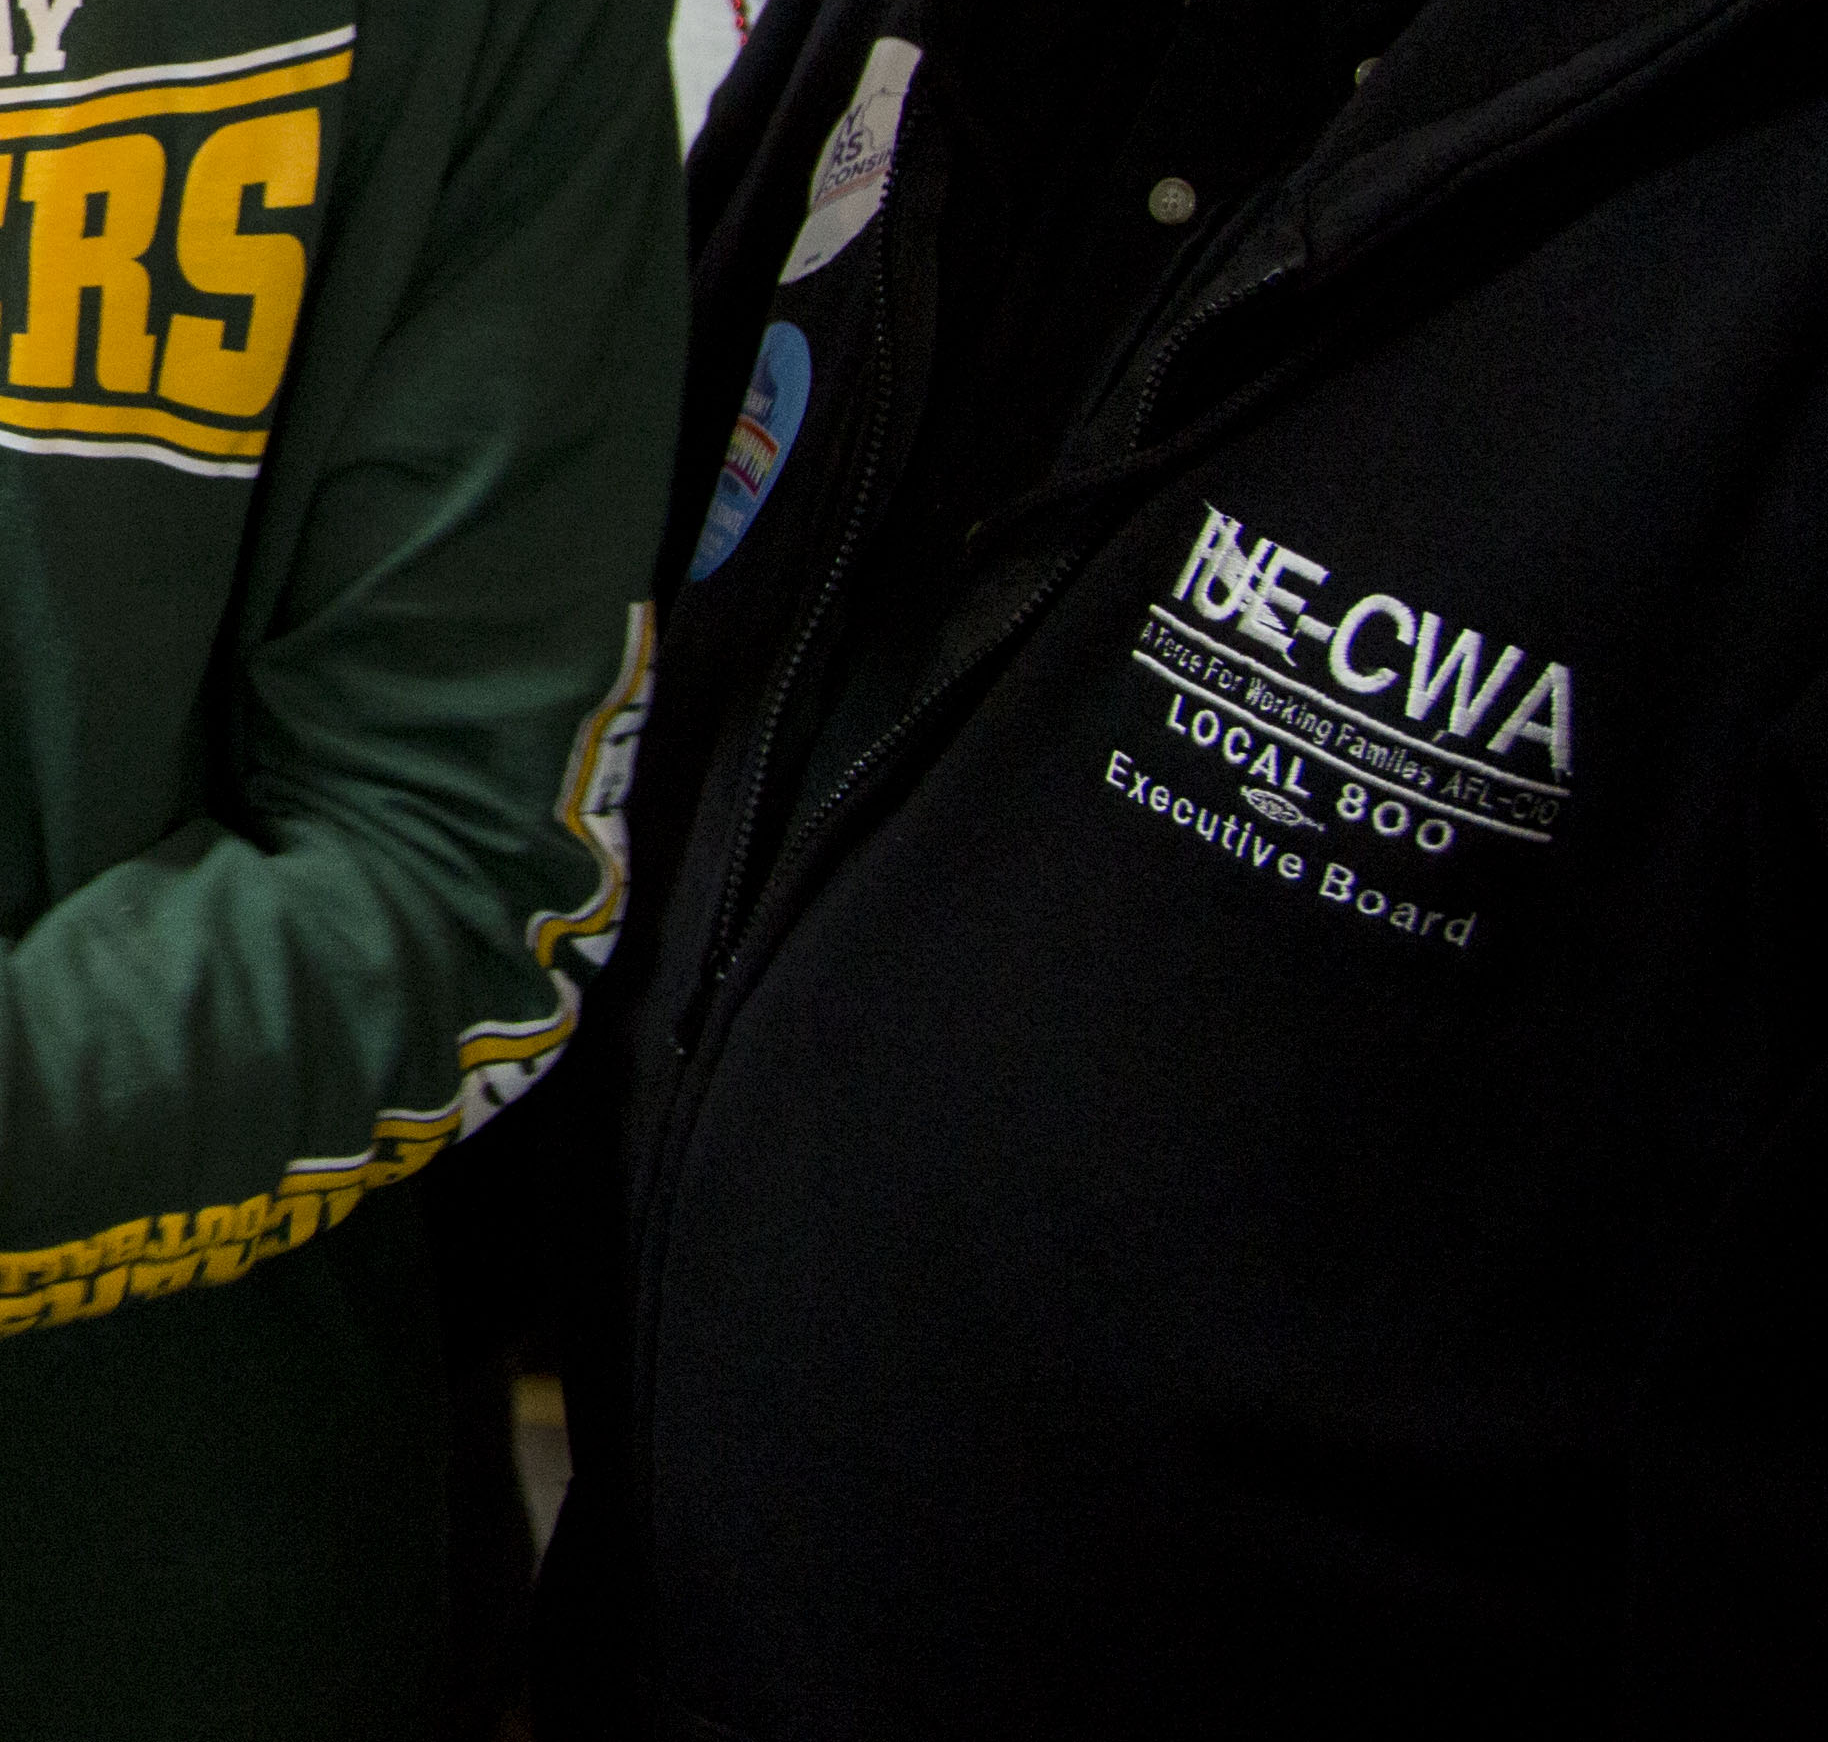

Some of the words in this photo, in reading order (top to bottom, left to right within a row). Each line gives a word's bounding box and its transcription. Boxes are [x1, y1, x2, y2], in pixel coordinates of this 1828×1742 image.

[1167, 693, 1313, 800] LOCAL
[1336, 782, 1457, 853] 800
[1203, 656, 1245, 693] For
[1245, 676, 1335, 746] Working
[1105, 749, 1307, 881] Executive
[1319, 861, 1478, 948] Board
